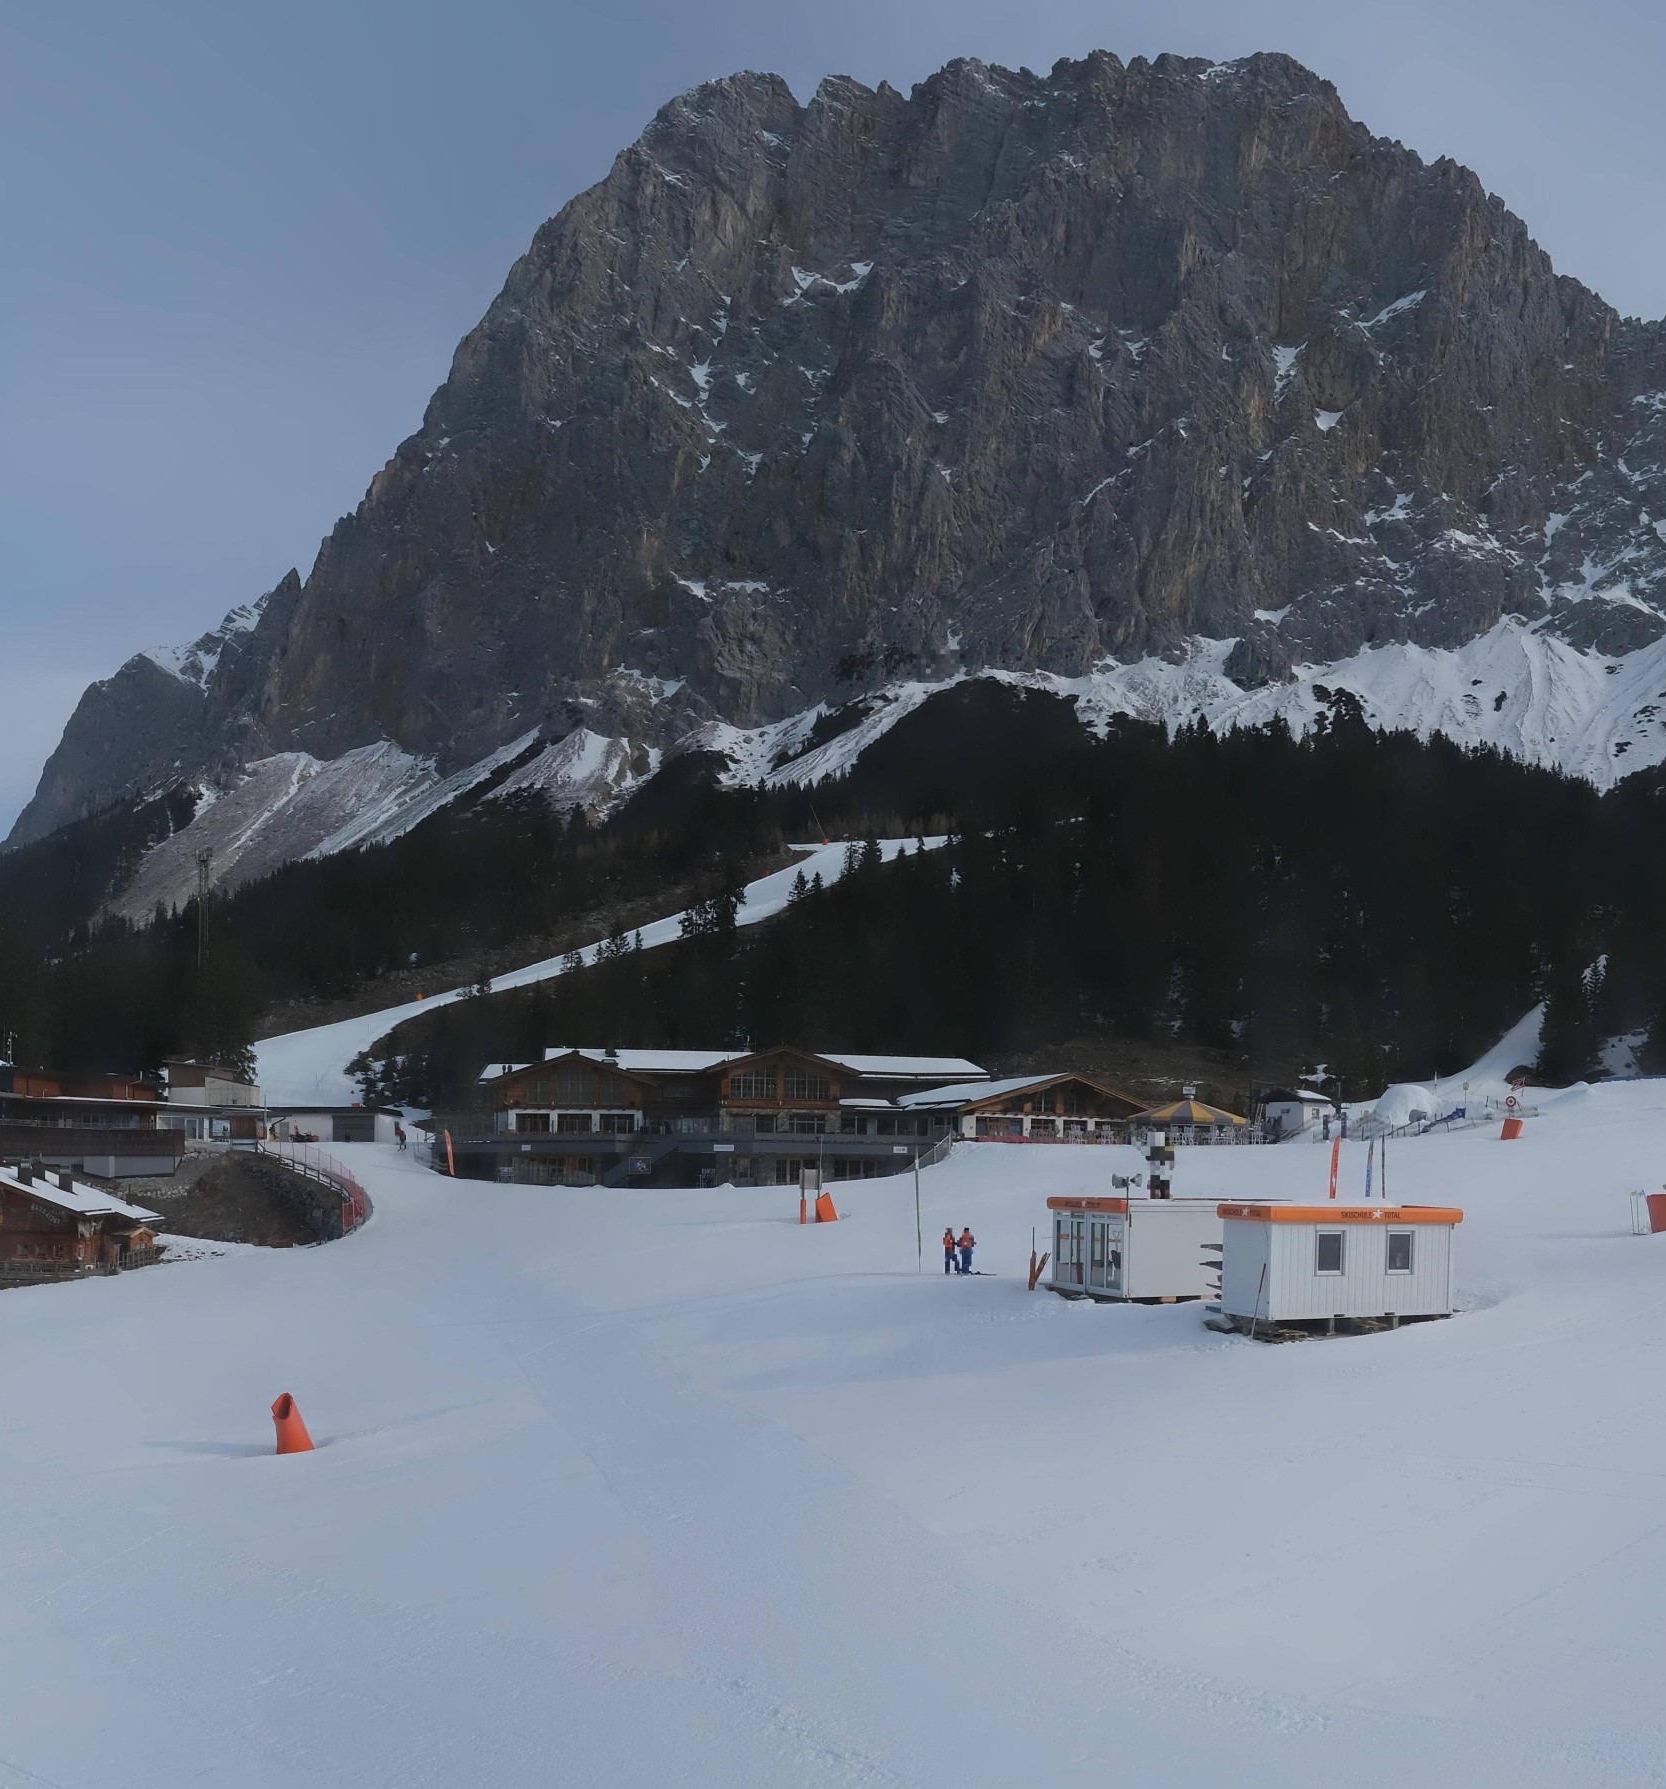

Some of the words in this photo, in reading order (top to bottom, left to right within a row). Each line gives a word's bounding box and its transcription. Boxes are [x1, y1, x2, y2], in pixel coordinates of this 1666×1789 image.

[1222, 1208, 1242, 1216] SKISCHULE
[1249, 1209, 1261, 1217] TOTAL
[1341, 1211, 1373, 1219] SKISCHULE
[1384, 1211, 1400, 1219] TOTAL
